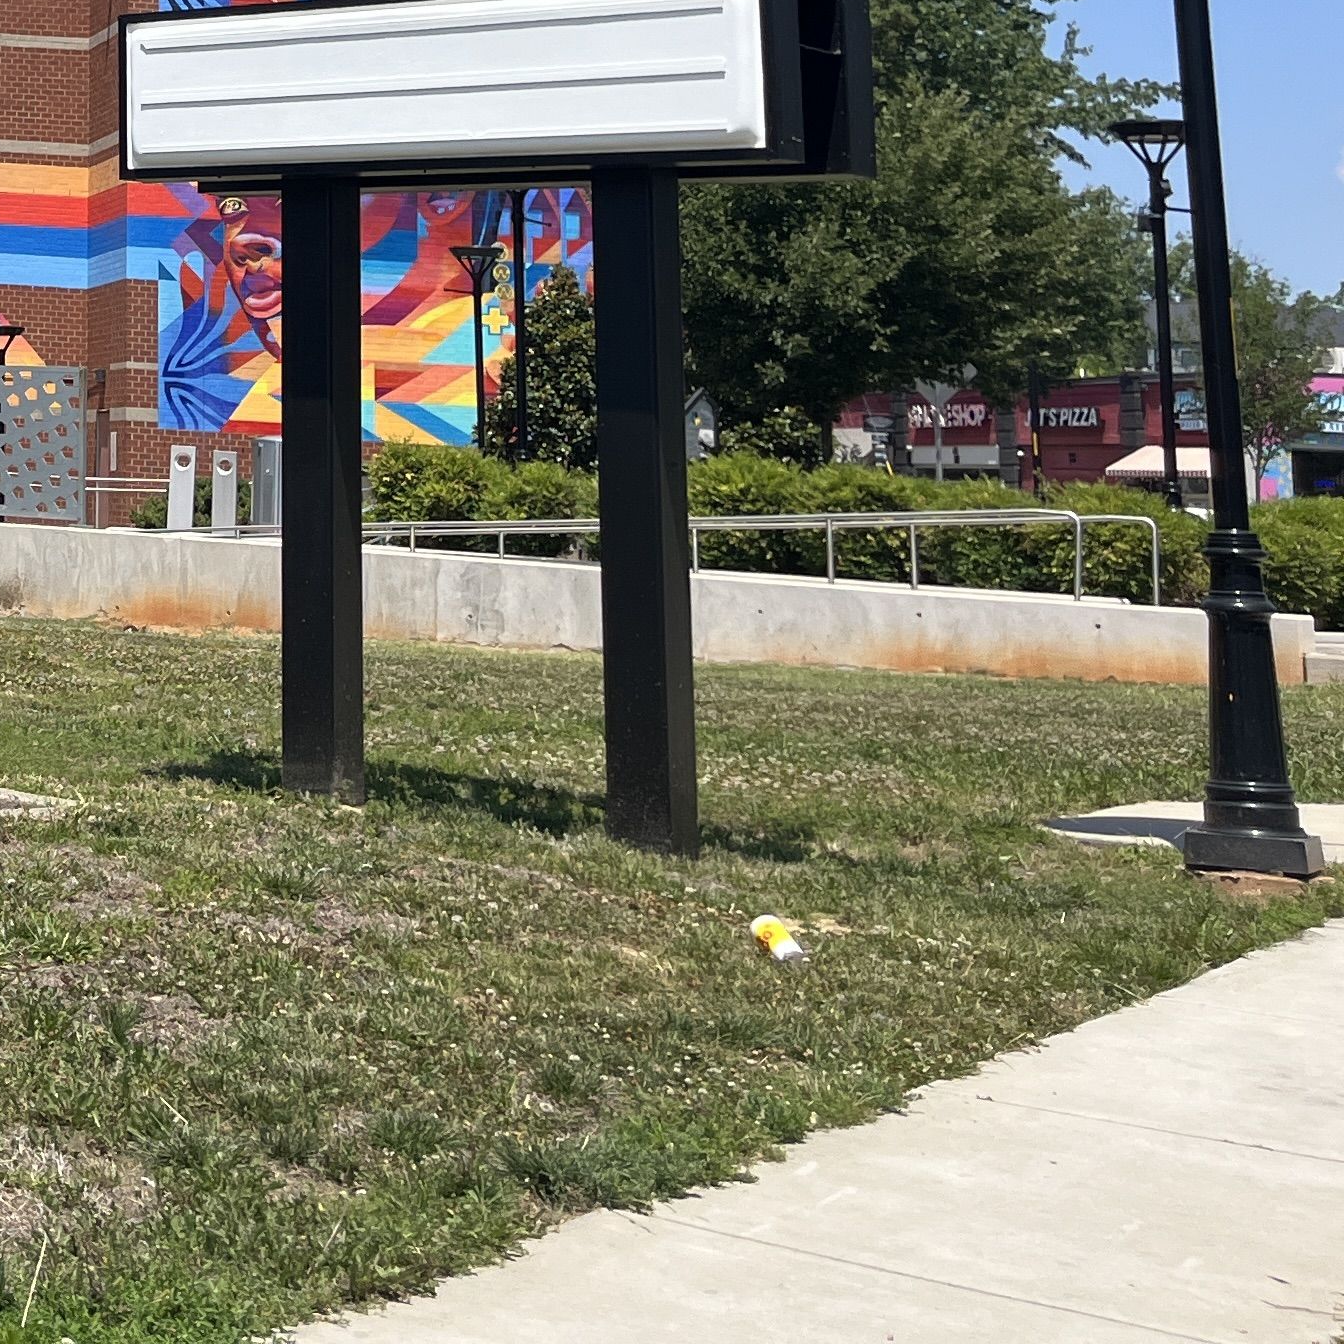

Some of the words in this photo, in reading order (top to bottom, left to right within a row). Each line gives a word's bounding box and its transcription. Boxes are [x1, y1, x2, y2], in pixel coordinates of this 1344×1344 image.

[952, 403, 986, 427] SHOP
[1024, 407, 1057, 427] JT'S
[1059, 406, 1098, 427] PIZZA
